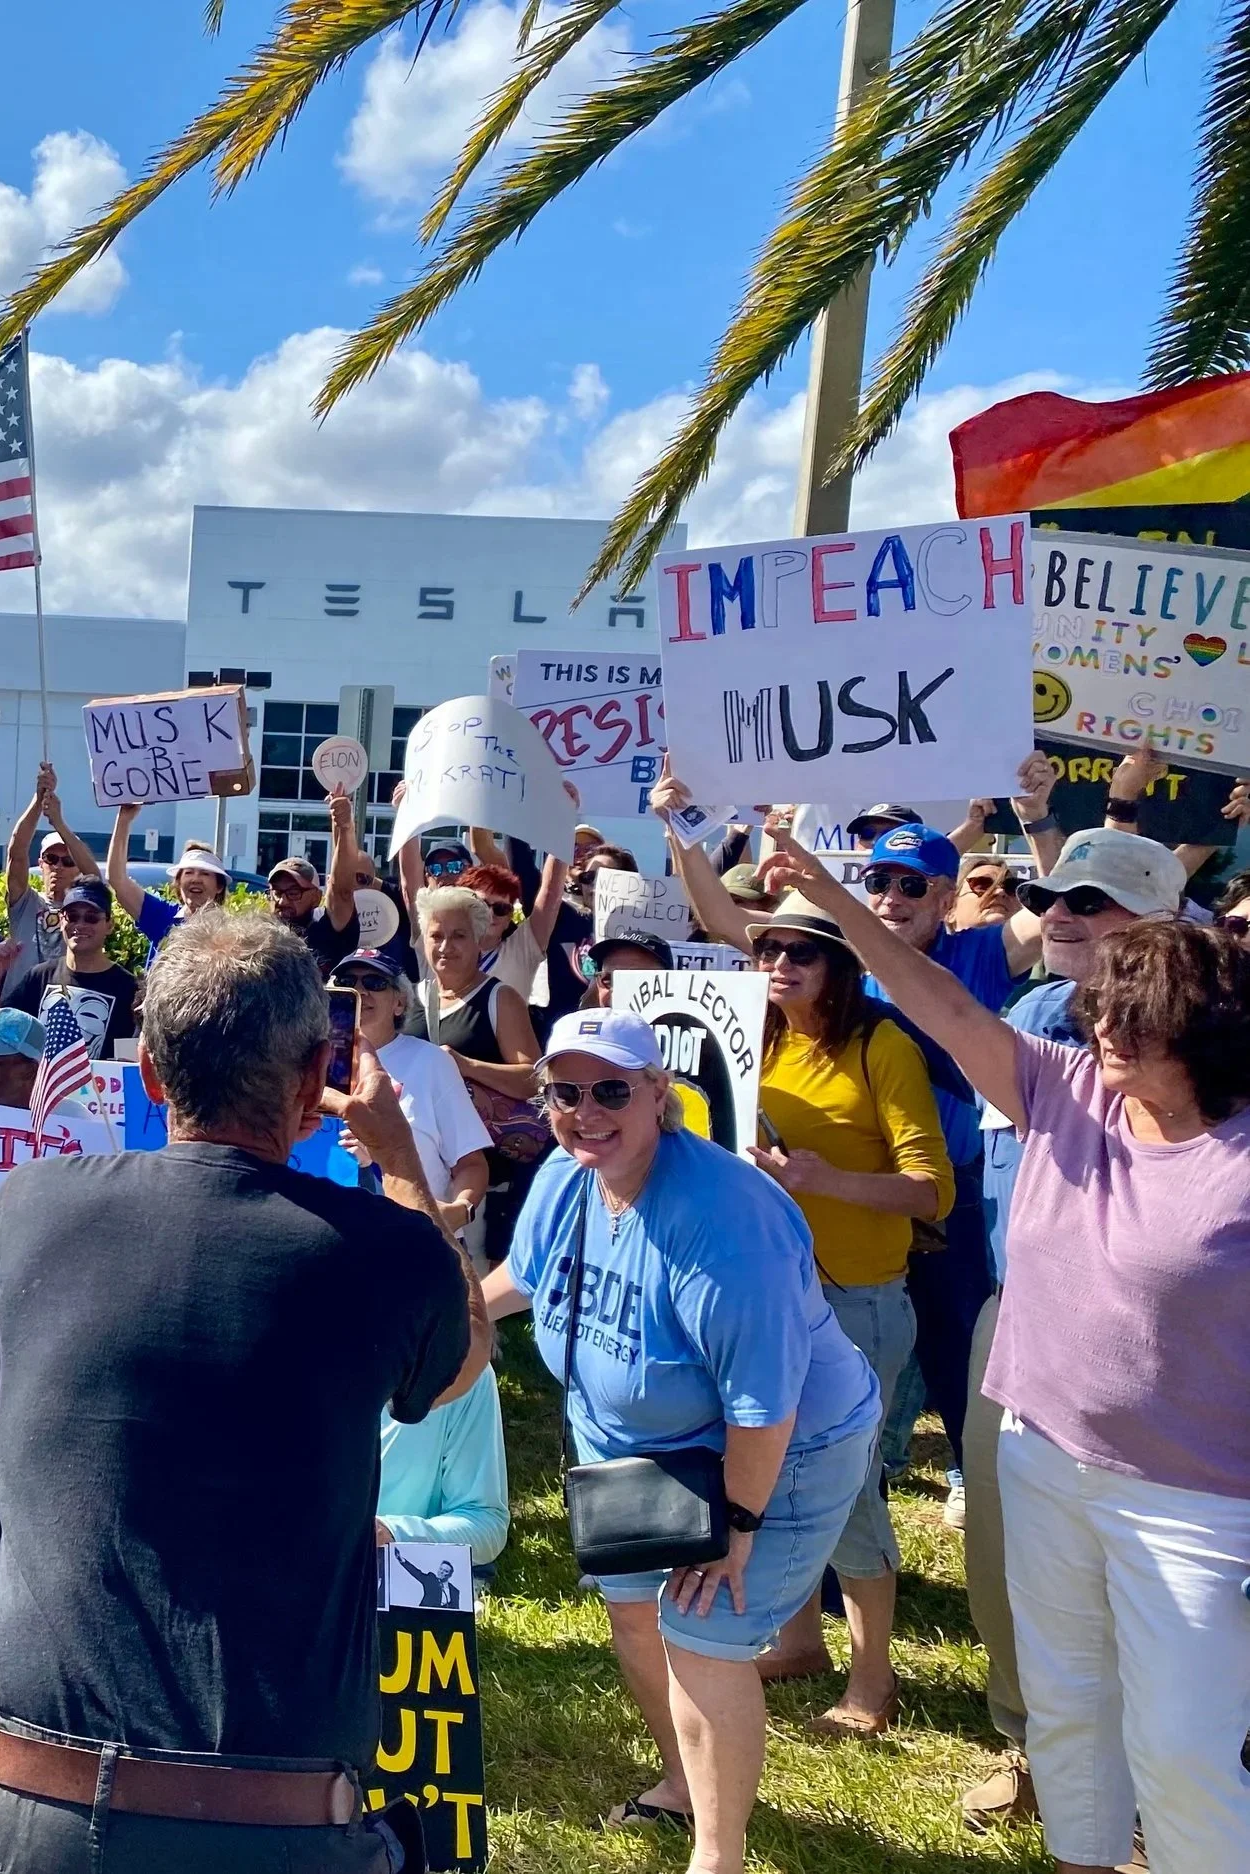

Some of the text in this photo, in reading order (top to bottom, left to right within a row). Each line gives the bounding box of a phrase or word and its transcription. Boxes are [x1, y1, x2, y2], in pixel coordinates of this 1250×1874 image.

[227, 580, 646, 628] TESLA
[664, 521, 1024, 642] IMPEACH
[540, 662, 598, 683] THIS
[607, 665, 630, 684] IS
[529, 694, 668, 766] RESI
[723, 667, 955, 764] MUSK
[1077, 711, 1215, 755] RIGHTS
[102, 760, 209, 798] GONE
[320, 750, 360, 770] ELON
[598, 894, 689, 923] NOT ELECT
[627, 875, 668, 899] DID
[361, 917, 379, 927] usk
[629, 972, 754, 1079] IBAL LECTOR
[650, 1024, 707, 1076] DIOT
[594, 1329, 640, 1365] ENERGY
[380, 1630, 475, 1695] UM
[377, 1709, 463, 1775] UT
